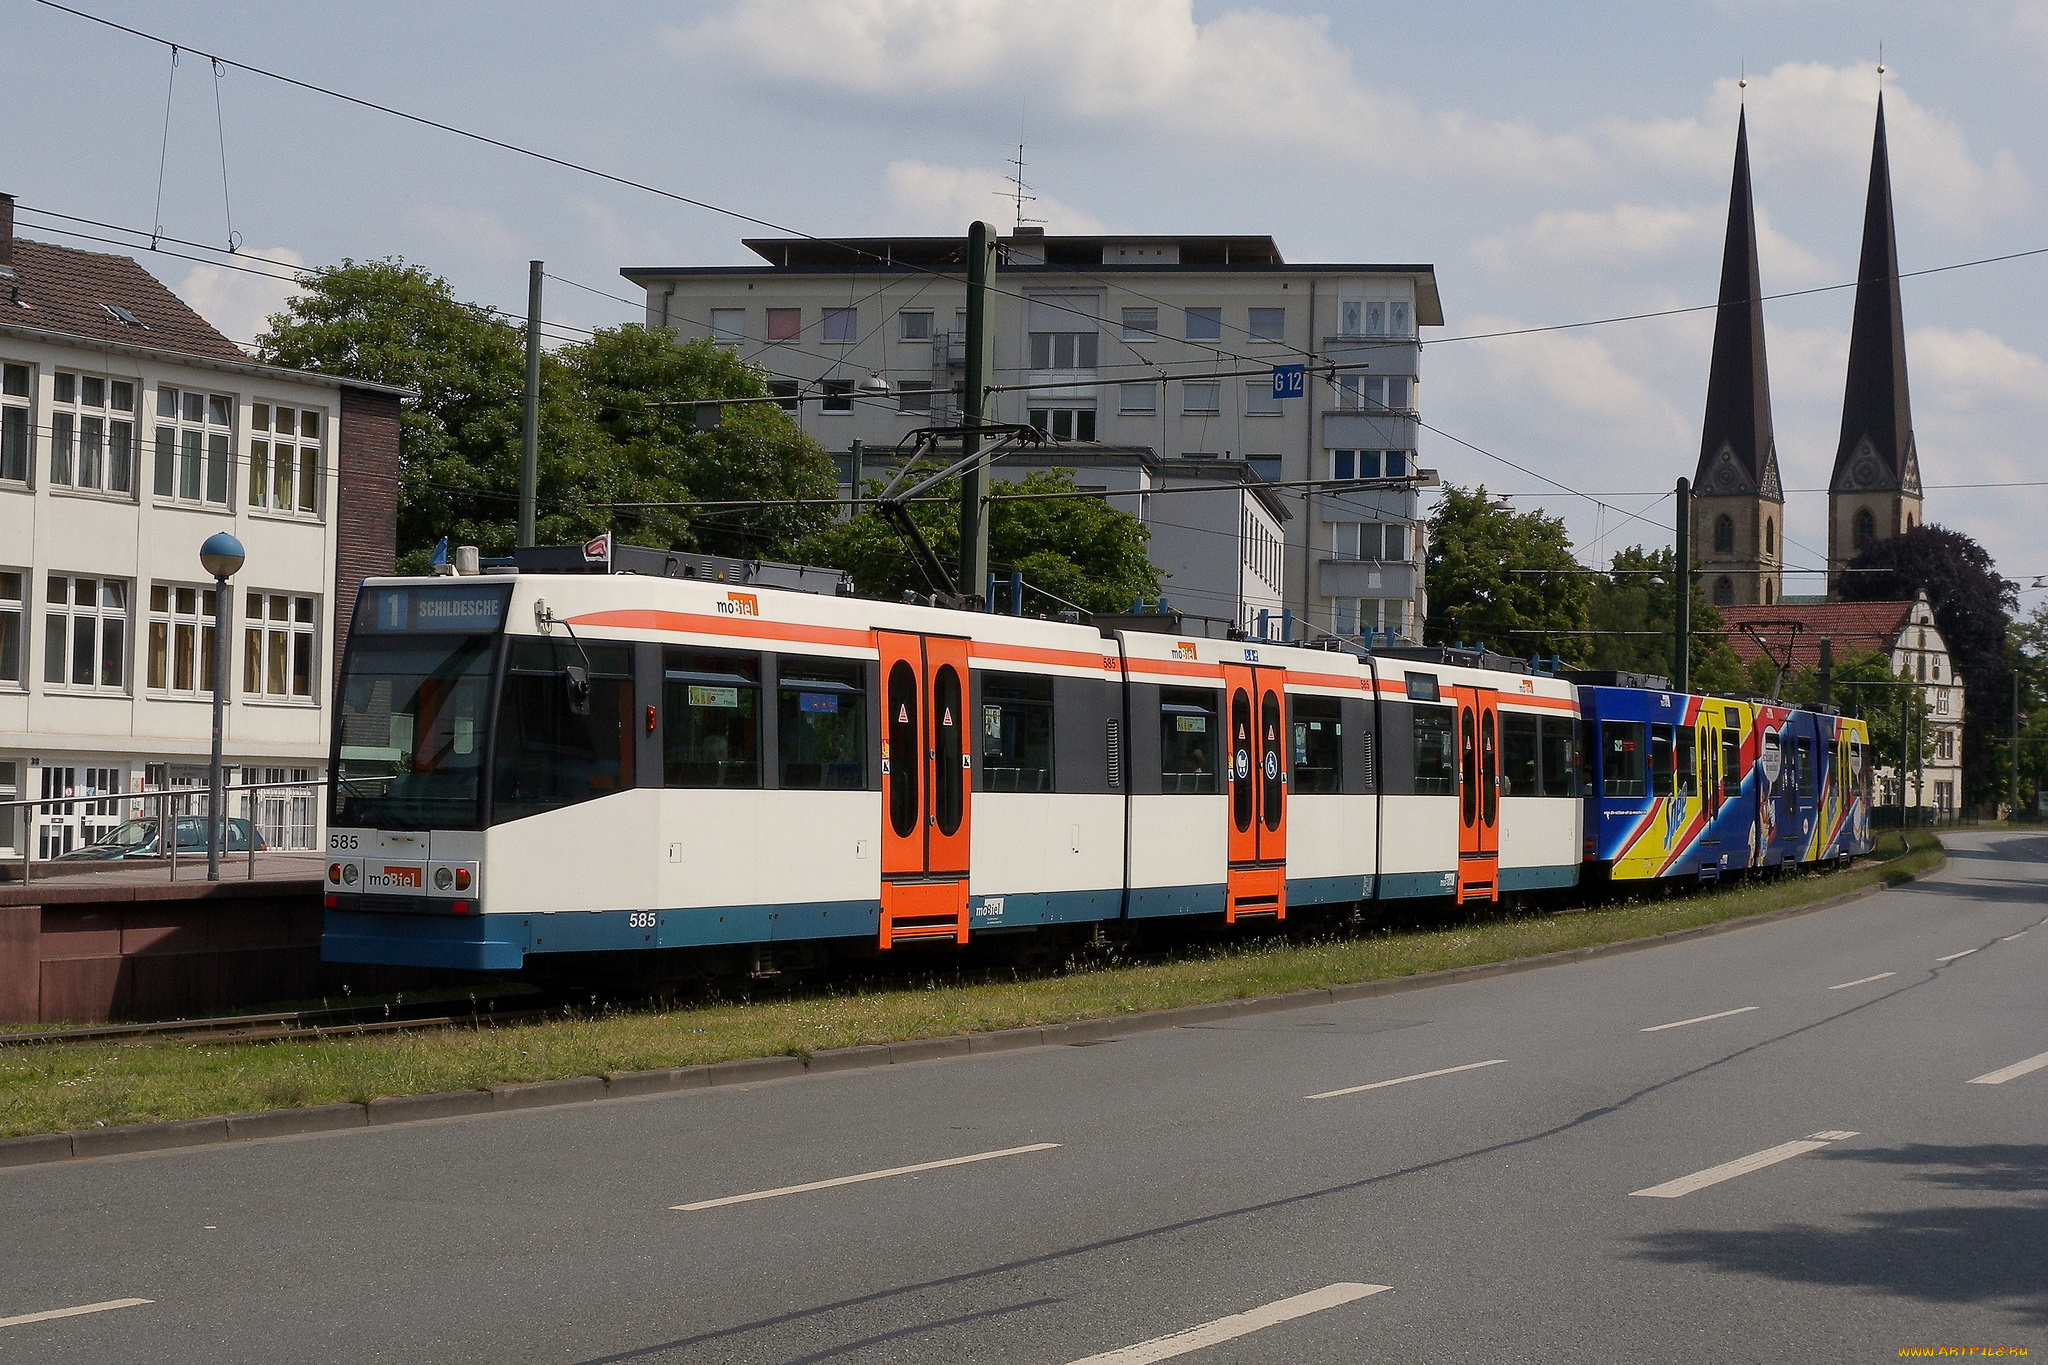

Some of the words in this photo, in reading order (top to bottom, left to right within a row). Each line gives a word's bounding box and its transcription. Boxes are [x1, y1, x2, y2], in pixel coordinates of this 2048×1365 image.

[1275, 372, 1284, 392] G
[1287, 371, 1302, 391] 12
[387, 593, 399, 627] 1
[419, 599, 499, 618] SCHILDESCHE
[716, 598, 754, 616] moBiel
[1171, 647, 1195, 660] moBiel
[1103, 657, 1116, 669] 585
[330, 834, 359, 850] 585
[368, 872, 416, 888] moBiel
[976, 902, 1001, 917] moBiel
[629, 912, 656, 928] 585
